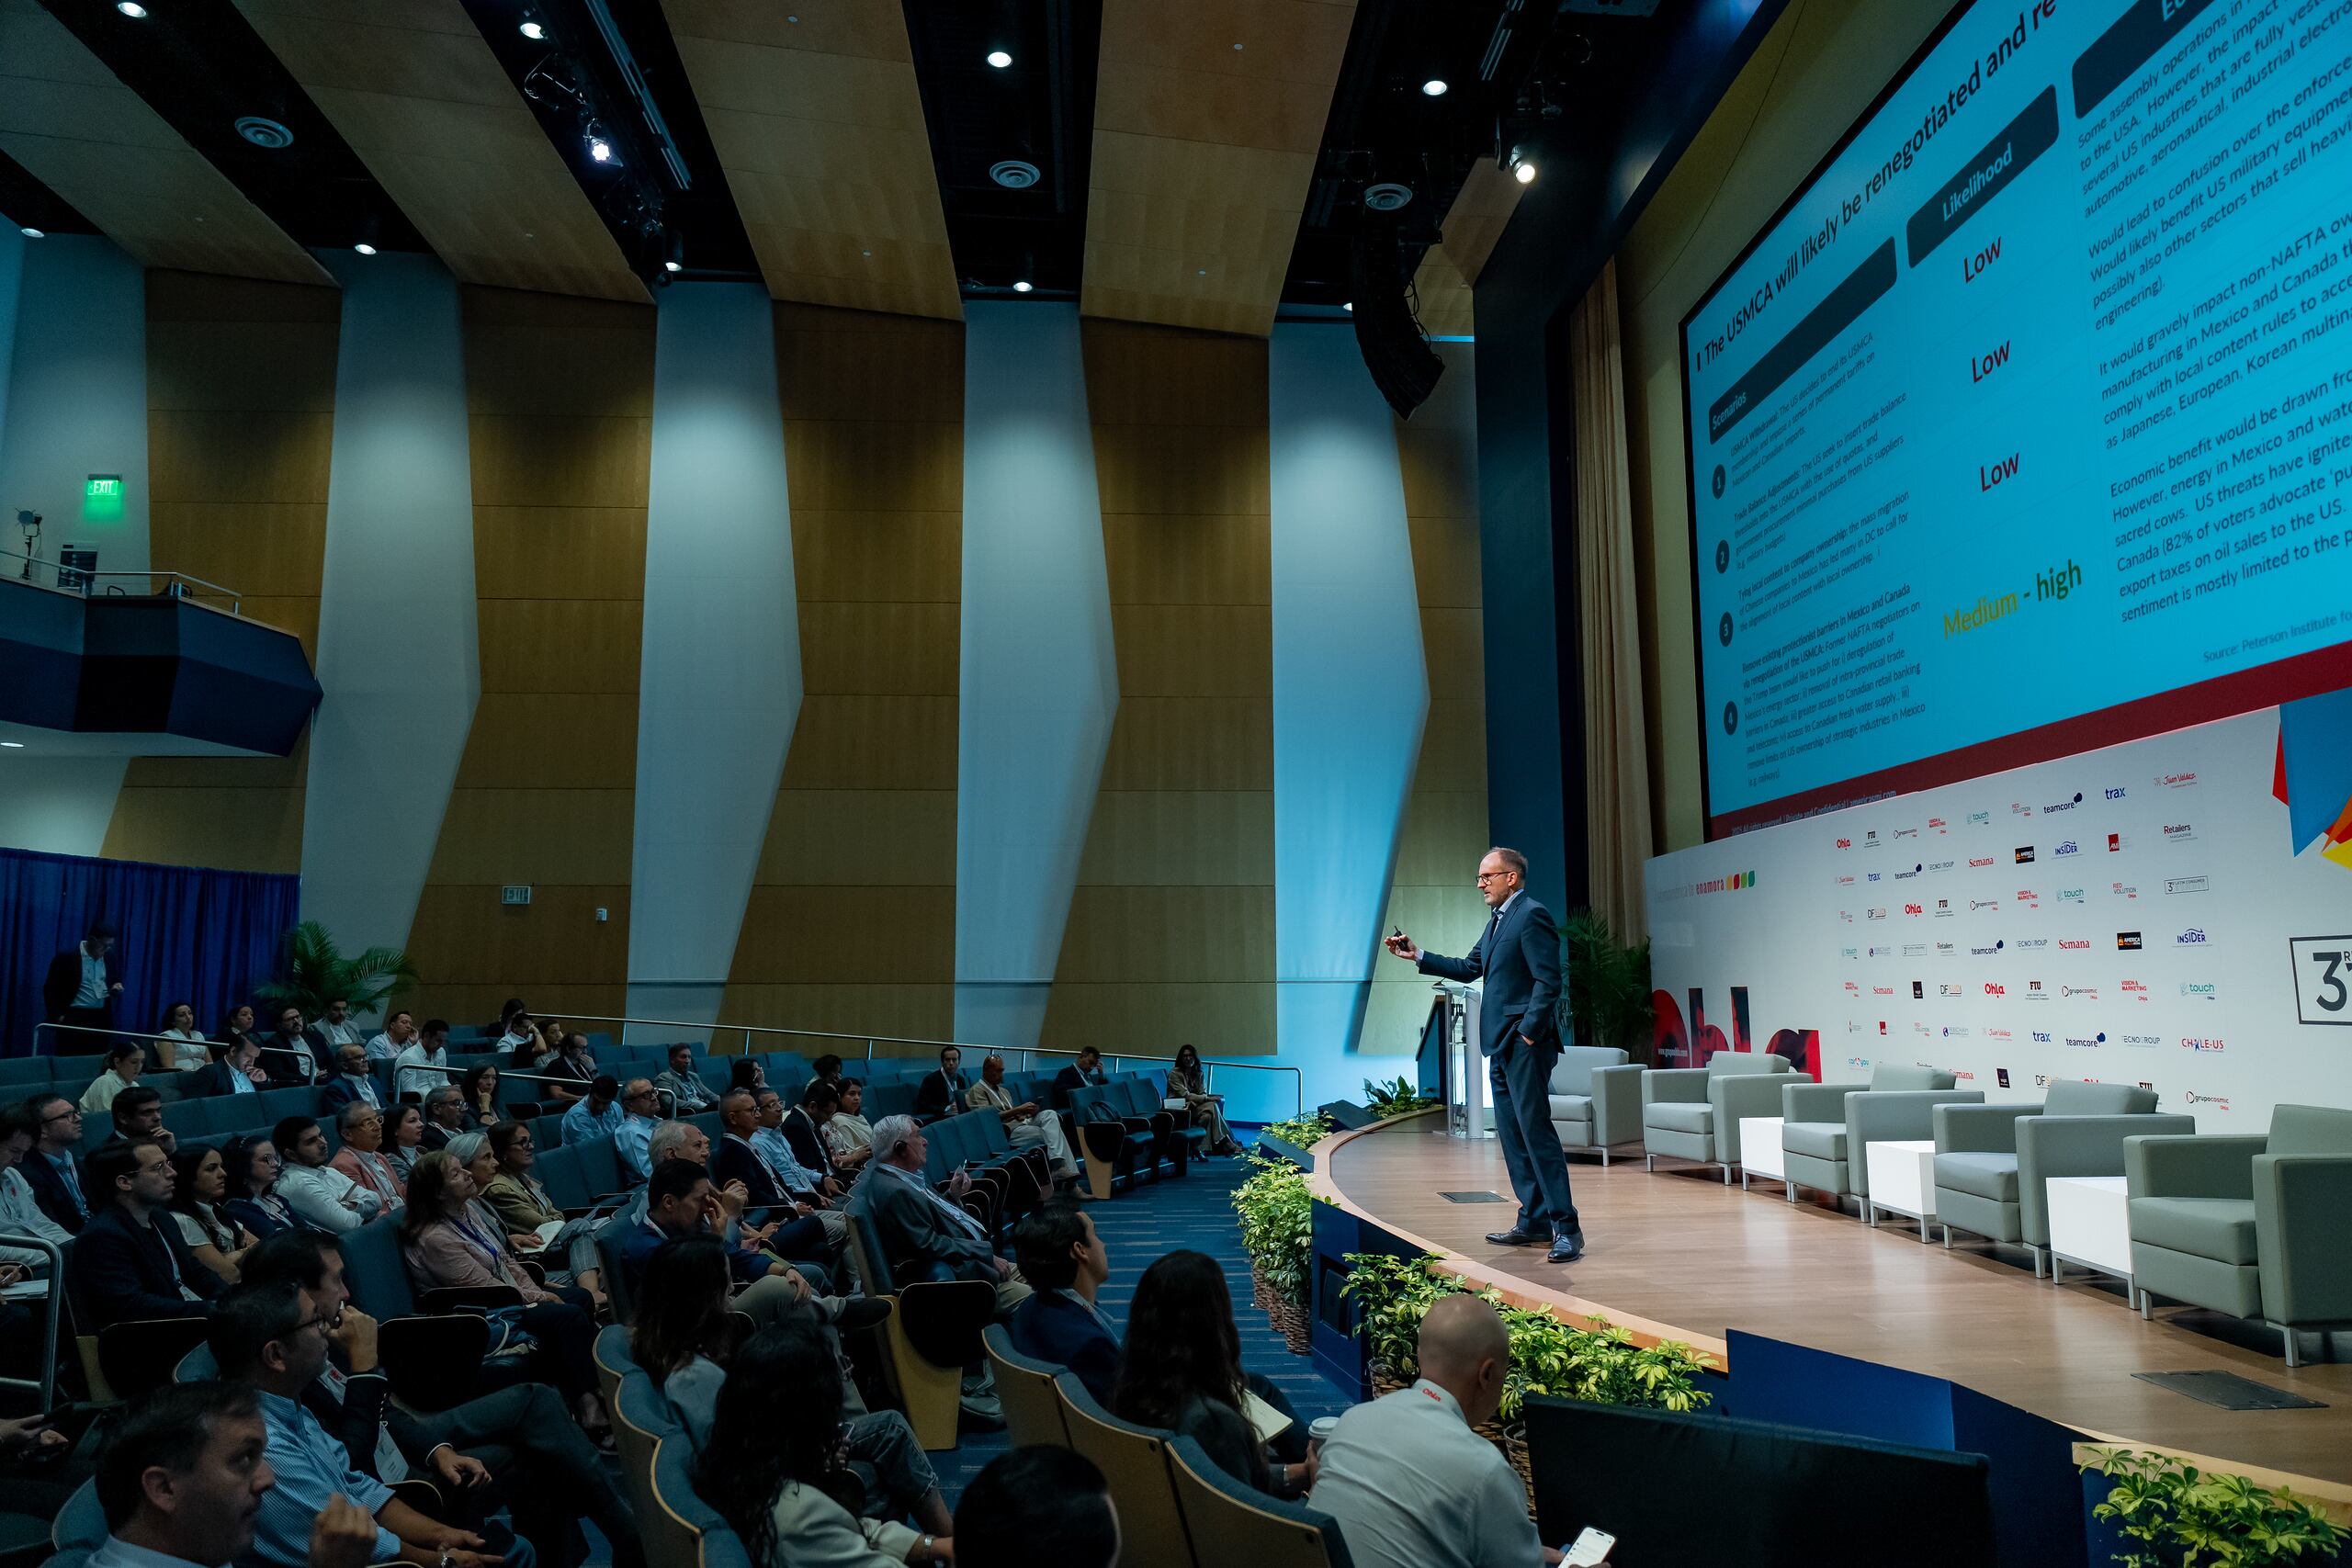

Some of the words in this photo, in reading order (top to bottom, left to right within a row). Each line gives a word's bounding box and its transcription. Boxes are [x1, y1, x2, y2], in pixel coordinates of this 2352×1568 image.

[2078, 117, 2107, 150] Some
[2110, 71, 2159, 122] assembly
[2163, 13, 2227, 76] operations
[2081, 156, 2092, 172] to
[2095, 139, 2111, 161] the
[2114, 115, 2142, 143] USA.
[2148, 62, 2205, 117] However,
[2208, 39, 2229, 64] the
[2233, 0, 2279, 44] impact
[2083, 153, 2120, 196] several
[2122, 140, 2138, 163] US
[2142, 95, 2199, 148] industries
[2201, 68, 2228, 99] that
[2231, 51, 2251, 75] are
[2255, 21, 2285, 55] fully
[2085, 164, 2149, 219] automotive,
[2152, 96, 2229, 167] aeronautical,
[2232, 39, 2295, 104] industrial
[2300, 0, 2352, 50] electro
[1704, 335, 1724, 366] The
[1727, 280, 1774, 343] USMCA
[1776, 250, 1799, 294] will
[1802, 214, 1839, 268] likely
[1842, 194, 1861, 227] be
[1866, 58, 1981, 204] renegotiated
[1986, 11, 2027, 78] and
[1943, 141, 2013, 222] Likelihood
[2089, 221, 2124, 259] Would
[2127, 202, 2150, 231] lead
[2153, 196, 2165, 212] to
[2169, 148, 2230, 201] confusion
[2233, 121, 2263, 152] over
[2267, 102, 2290, 128] the
[2091, 245, 2127, 283] Would
[2130, 227, 2158, 256] likely
[2161, 192, 2204, 233] benefit
[2208, 175, 2227, 199] US
[2230, 139, 2280, 185] military
[2094, 269, 2136, 311] possibly
[2140, 253, 2162, 276] also
[2165, 227, 2197, 258] other
[2200, 192, 2247, 233] sectors
[2251, 168, 2279, 198] that
[2283, 146, 2307, 177] sell
[1964, 236, 2002, 284] Low
[2096, 275, 2165, 331] engineering).
[2100, 361, 2108, 377] It
[2110, 337, 2144, 369] would
[2148, 312, 2189, 351] gravely
[2193, 282, 2236, 320] impact
[2240, 226, 2327, 291] non-NAFTA
[1973, 339, 2010, 384] Low
[2104, 394, 2143, 425] comply
[2147, 376, 2173, 401] with
[2176, 355, 2204, 386] local
[2208, 326, 2259, 367] content
[2263, 308, 2297, 336] rules
[2301, 297, 2317, 314] to
[1713, 391, 1747, 431] Scenarios
[2107, 434, 2119, 450] as
[2121, 405, 2177, 443] Japanese,
[2179, 369, 2243, 412] European,
[2247, 337, 2298, 375] Korean
[2111, 461, 2165, 499] Economic
[2168, 436, 2212, 470] benefit
[2215, 412, 2256, 446] would
[2260, 407, 2278, 425] be
[2282, 382, 2329, 414] drawn
[94, 480, 113, 494] EXIT
[1981, 452, 2019, 493] Low
[2113, 489, 2168, 523] However,
[2171, 467, 2212, 496] energy
[2217, 459, 2229, 476] in
[2232, 434, 2283, 468] Mexico
[2288, 415, 2314, 443] and
[2116, 518, 2152, 547] sacred
[2154, 507, 2188, 530] cows.
[2196, 491, 2214, 513] US
[2218, 472, 2266, 503] threats
[2268, 456, 2303, 481] have
[2118, 545, 2159, 572] Canada
[2163, 528, 2194, 557] (82%
[2197, 521, 2211, 540] of
[2213, 506, 2256, 533] voters
[2260, 477, 2326, 515] advocate
[2120, 572, 2156, 598] export
[2160, 560, 2191, 582] taxes
[2195, 553, 2211, 569] on
[2215, 540, 2231, 561] oil
[2234, 531, 2267, 554] sales
[2271, 524, 2287, 539] to
[2290, 513, 2315, 532] the
[2320, 498, 2346, 520] US.
[1944, 592, 2018, 638] Medium
[2037, 558, 2082, 603] high
[2203, 645, 2239, 663] Source:
[2243, 630, 2289, 652] Peterson
[2290, 615, 2337, 637] Institute
[1973, 811, 1989, 821] touch
[2105, 786, 2126, 800] trax
[1837, 838, 1851, 849] Ohla
[2164, 824, 2191, 834] Retailers
[1868, 873, 1881, 882] trax
[1894, 871, 1917, 880] teamcore
[1969, 857, 1994, 867] Semana
[1696, 879, 1724, 895] enamora
[1905, 903, 1923, 916] Ohla
[2064, 888, 2084, 897] touch
[1971, 947, 1997, 955] teamcore
[2058, 939, 2090, 950] Semana
[1872, 986, 1894, 995] Semana
[1984, 983, 2005, 996] Ohla
[2189, 983, 2215, 993] touch
[2032, 1031, 2051, 1043] trax
[2065, 1038, 2098, 1047] teamcore
